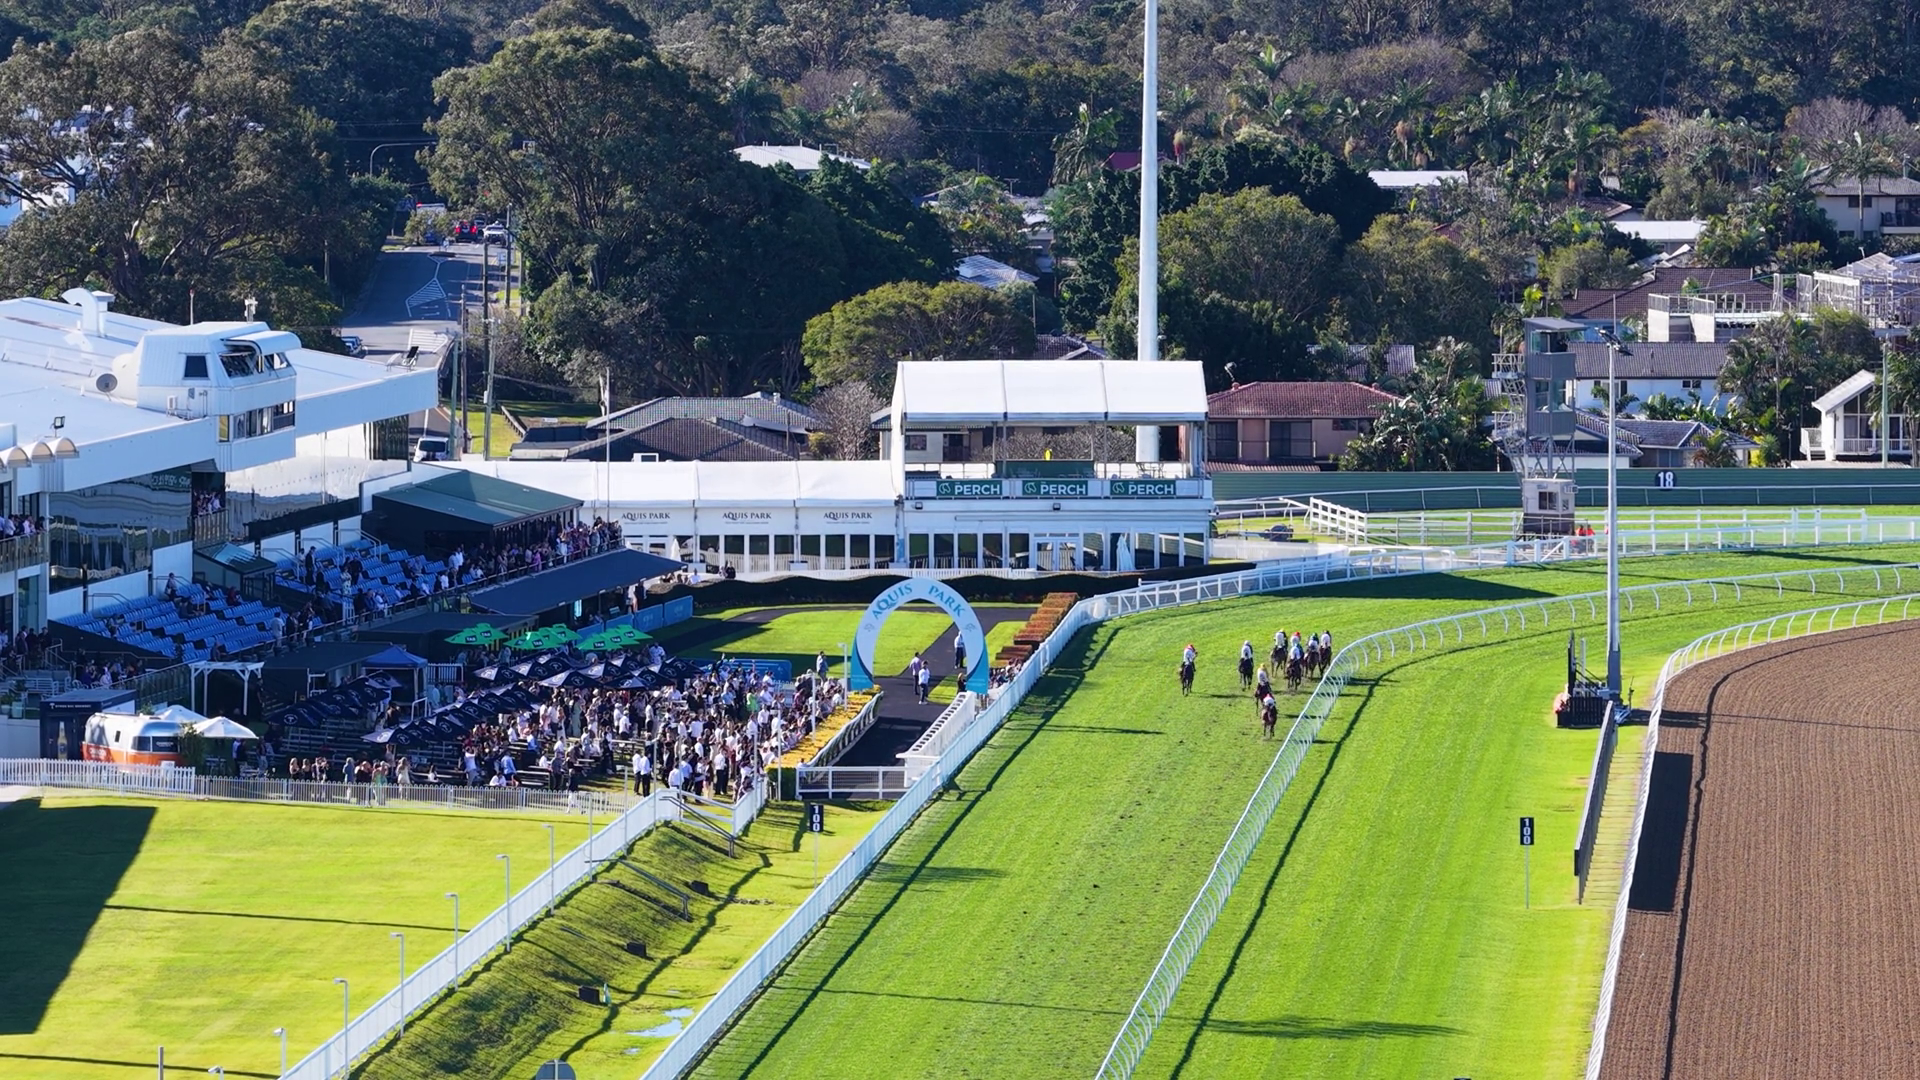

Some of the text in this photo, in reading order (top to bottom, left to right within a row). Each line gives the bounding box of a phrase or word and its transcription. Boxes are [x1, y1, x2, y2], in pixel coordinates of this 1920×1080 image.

[1658, 471, 1674, 488] 18
[955, 484, 1000, 495] PERCH
[1040, 484, 1086, 495] PERCH
[1128, 484, 1174, 495] PERCH
[621, 512, 647, 521] AQUIS
[722, 512, 748, 521] AQUIS
[823, 512, 849, 521] AQUIS
[872, 583, 966, 619] AQUIS PARK
